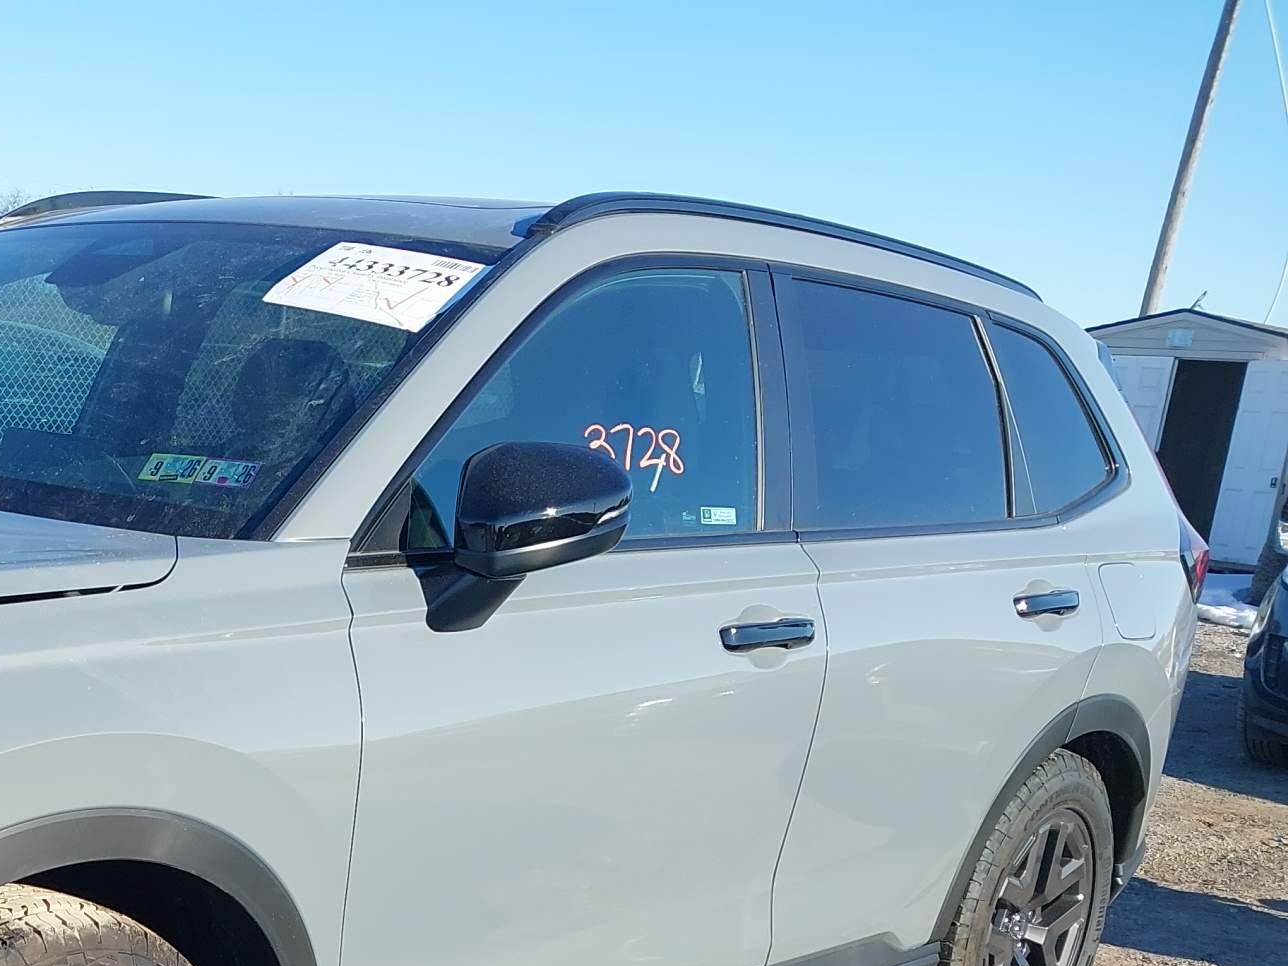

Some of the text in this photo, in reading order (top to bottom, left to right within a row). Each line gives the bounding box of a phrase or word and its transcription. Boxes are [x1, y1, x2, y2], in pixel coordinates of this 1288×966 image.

[328, 256, 460, 289] 44333728
[584, 423, 684, 475] 3728
[179, 459, 202, 479] 26
[235, 464, 257, 484] 26
